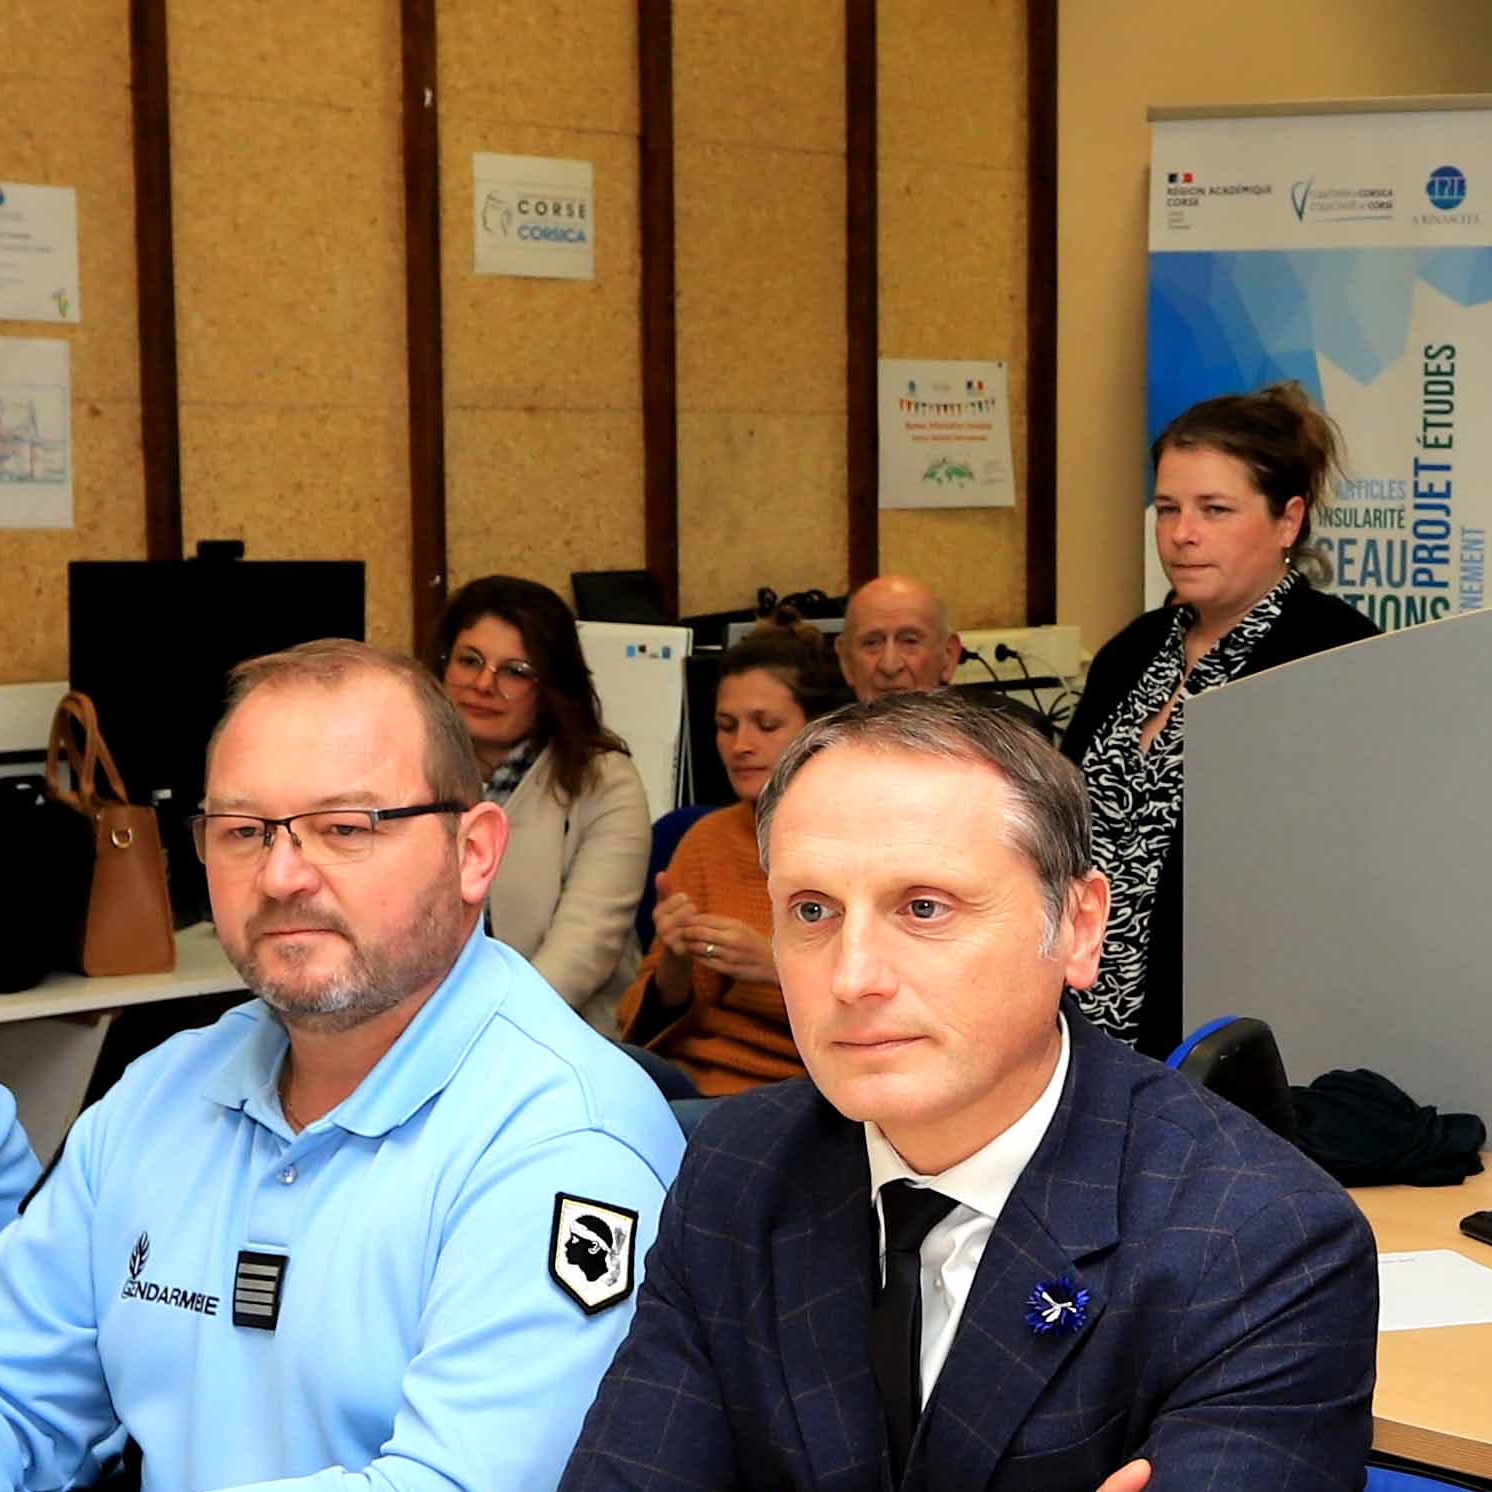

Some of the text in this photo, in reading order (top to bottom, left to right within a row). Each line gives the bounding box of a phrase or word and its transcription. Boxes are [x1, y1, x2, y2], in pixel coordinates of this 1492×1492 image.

[517, 199, 586, 219] CORSE
[1416, 344, 1457, 449] ÉTUDES
[1412, 457, 1453, 589] PROJET
